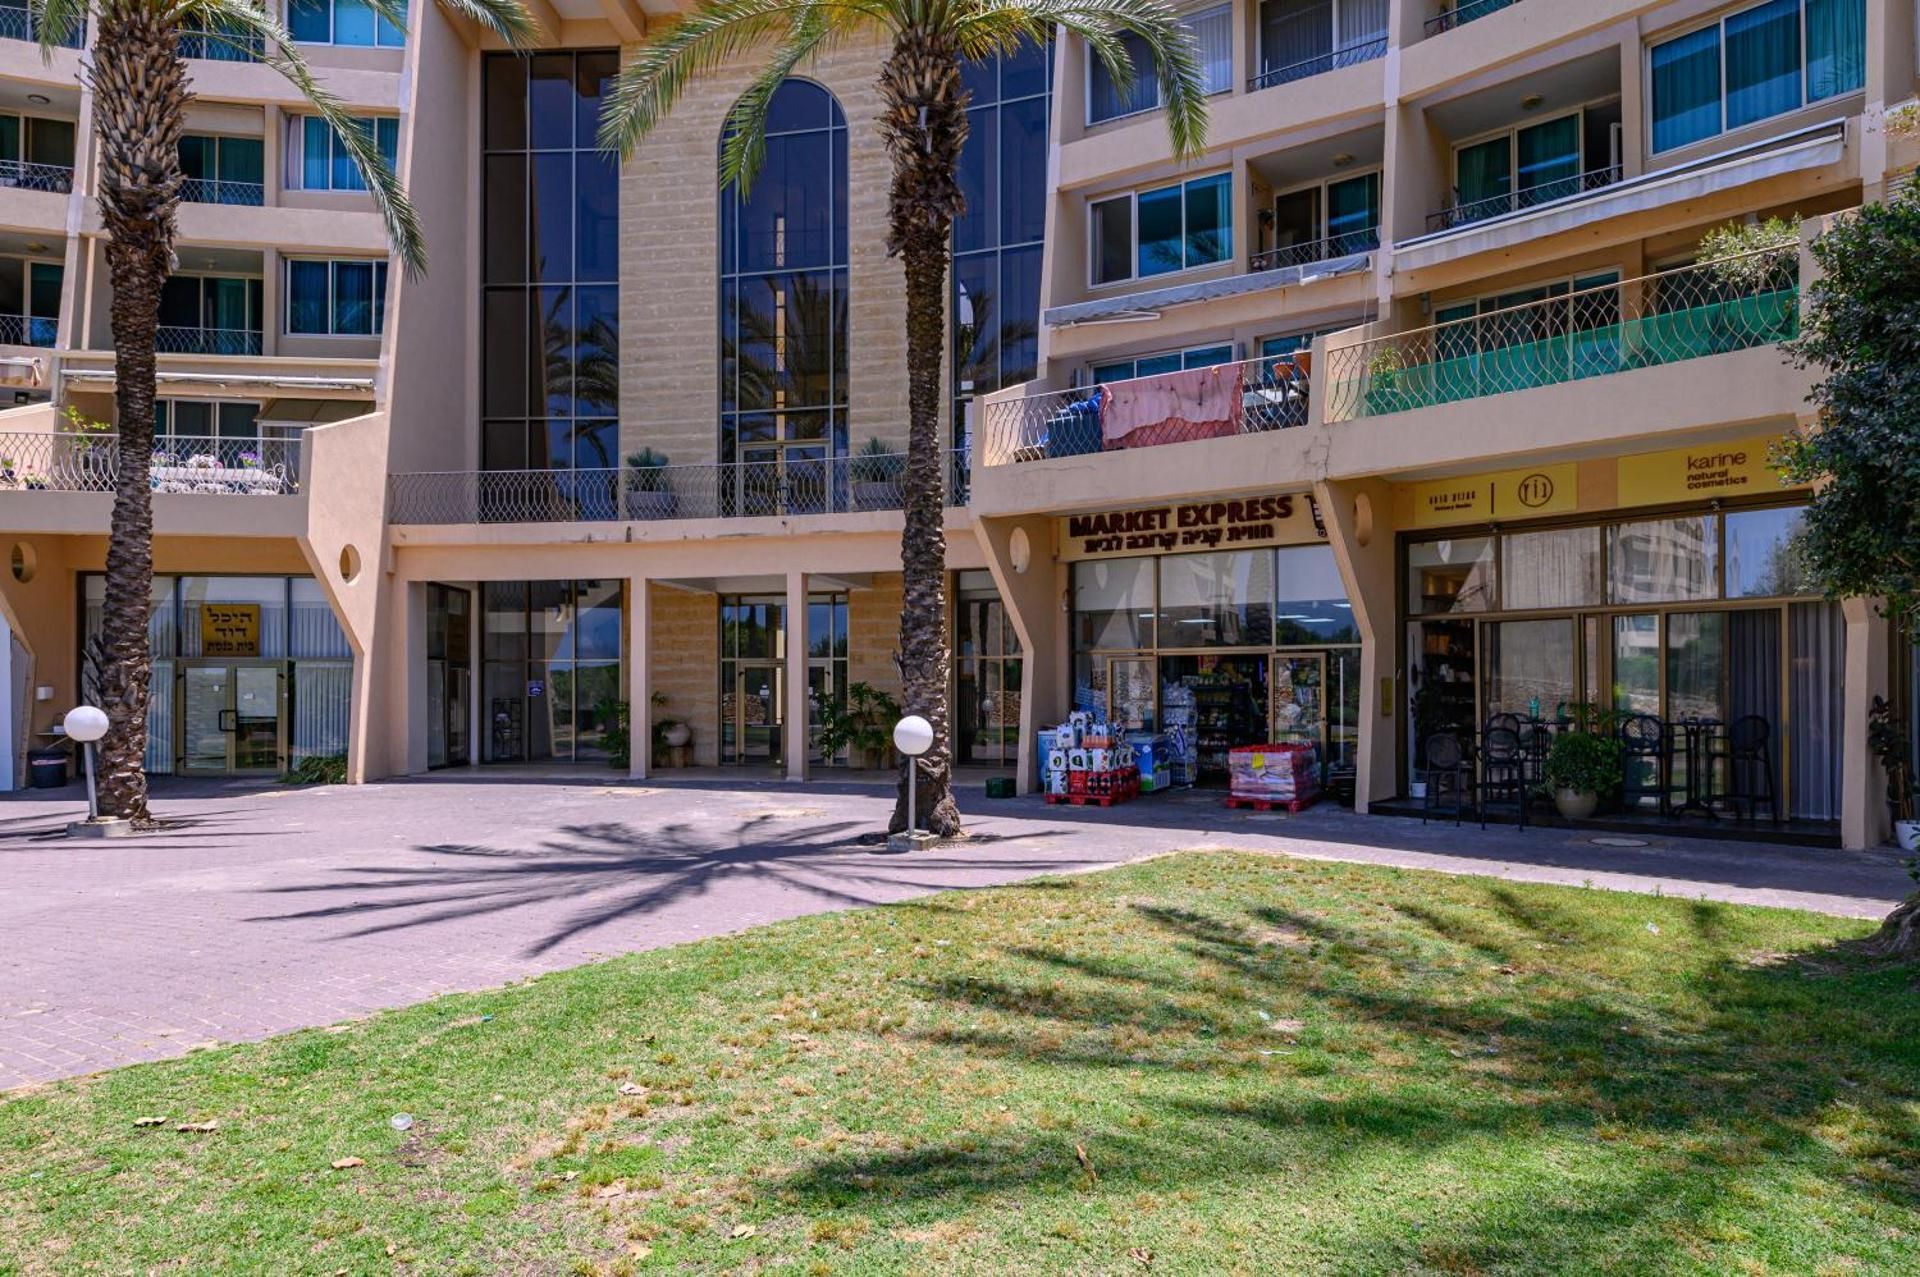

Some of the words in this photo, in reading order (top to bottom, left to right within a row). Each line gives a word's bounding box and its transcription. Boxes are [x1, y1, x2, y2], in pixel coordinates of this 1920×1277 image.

[1687, 451, 1746, 471] karine
[1687, 468, 1729, 482] natural
[1687, 475, 1748, 490] cosmetics
[1070, 508, 1171, 537] MARKET
[1177, 495, 1293, 528] EXPRESS
[206, 605, 252, 623] היכל
[215, 627, 246, 638] דוד
[236, 641, 254, 651] בית
